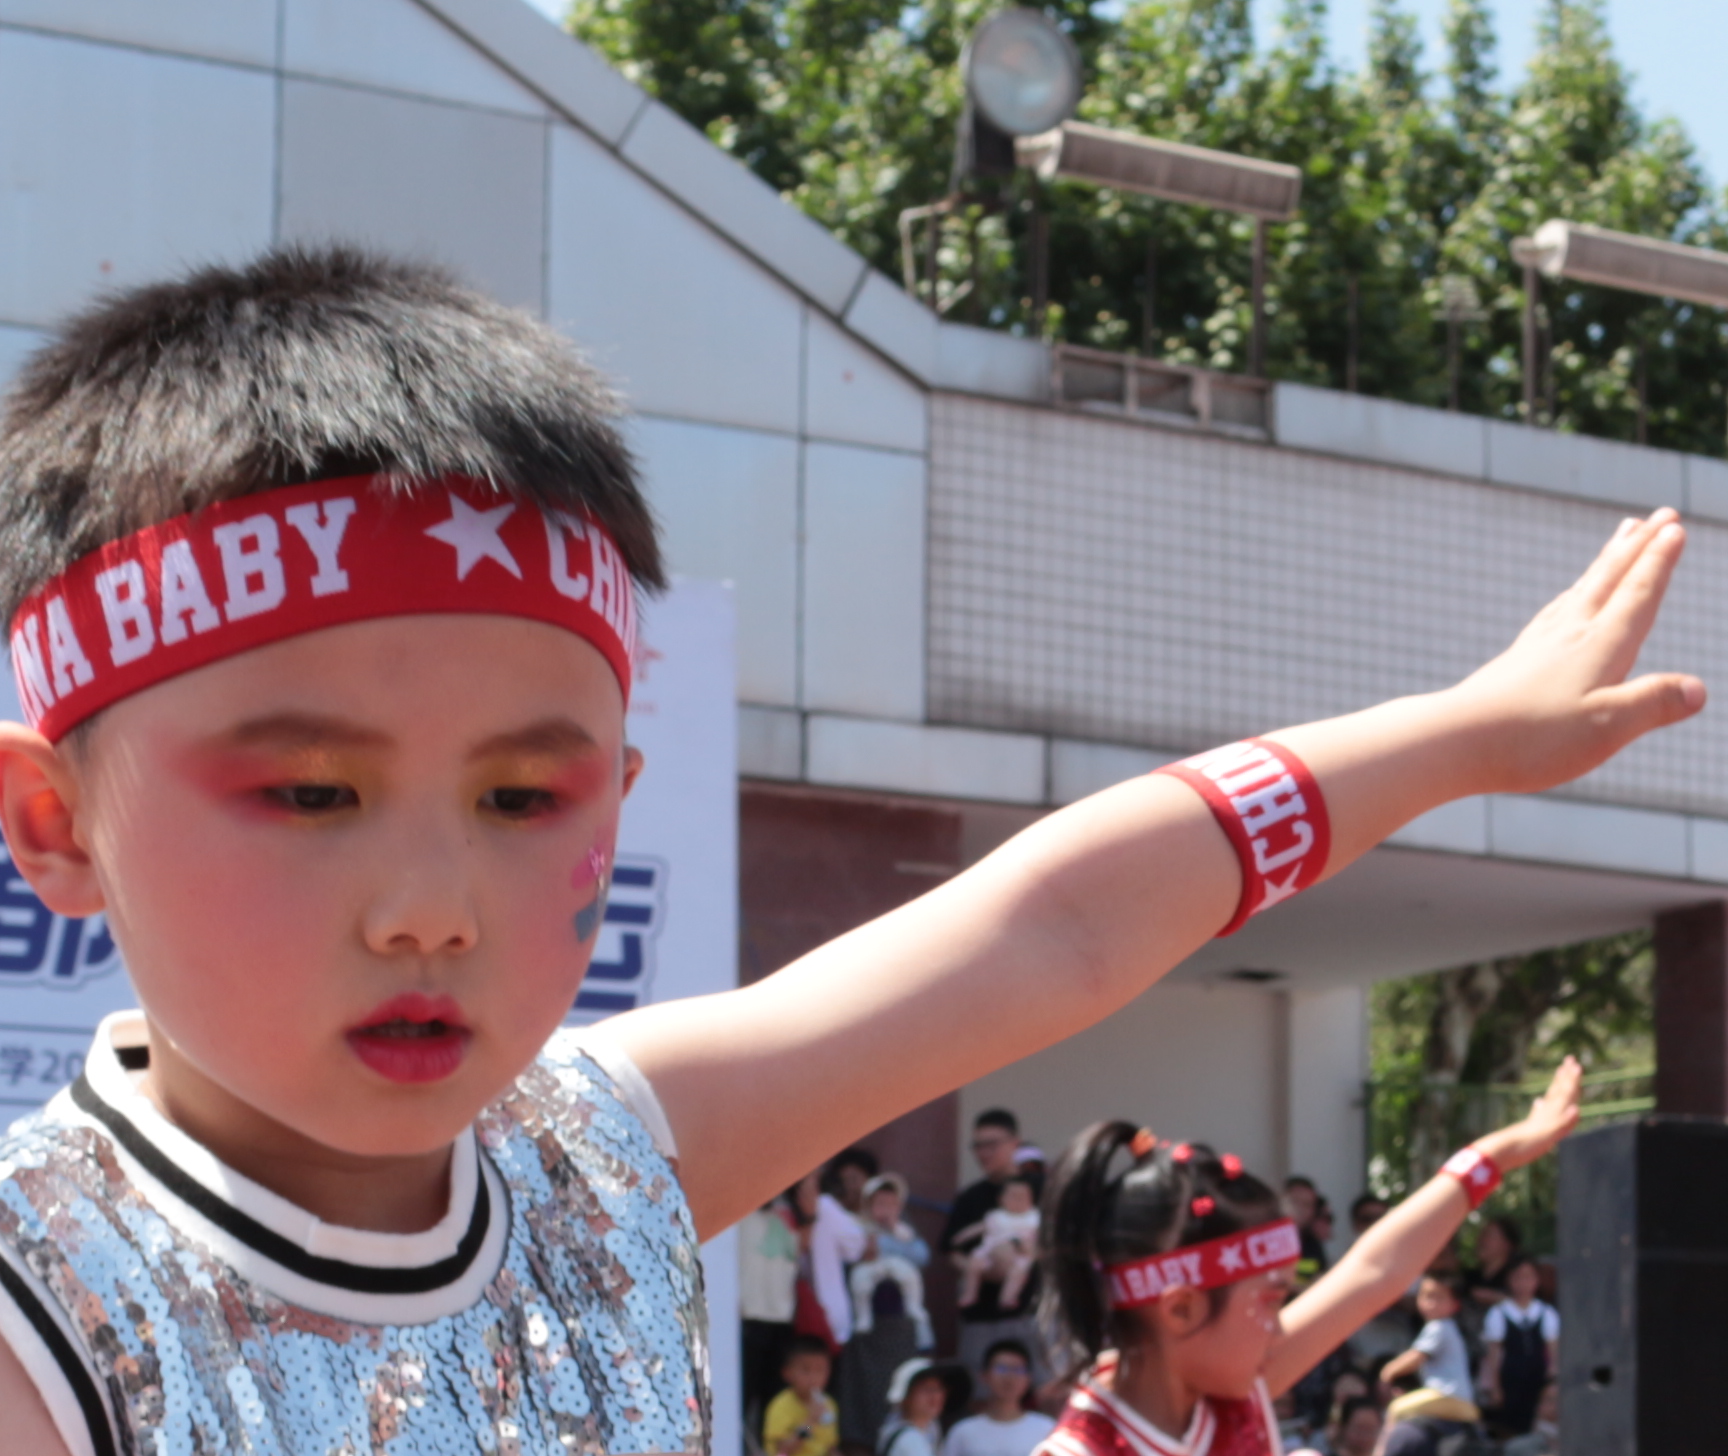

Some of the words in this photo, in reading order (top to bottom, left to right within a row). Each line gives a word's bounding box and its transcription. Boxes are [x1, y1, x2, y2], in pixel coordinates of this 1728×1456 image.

[12, 594, 95, 731] NA
[95, 497, 356, 667] BABY
[1124, 1252, 1203, 1300] BABY
